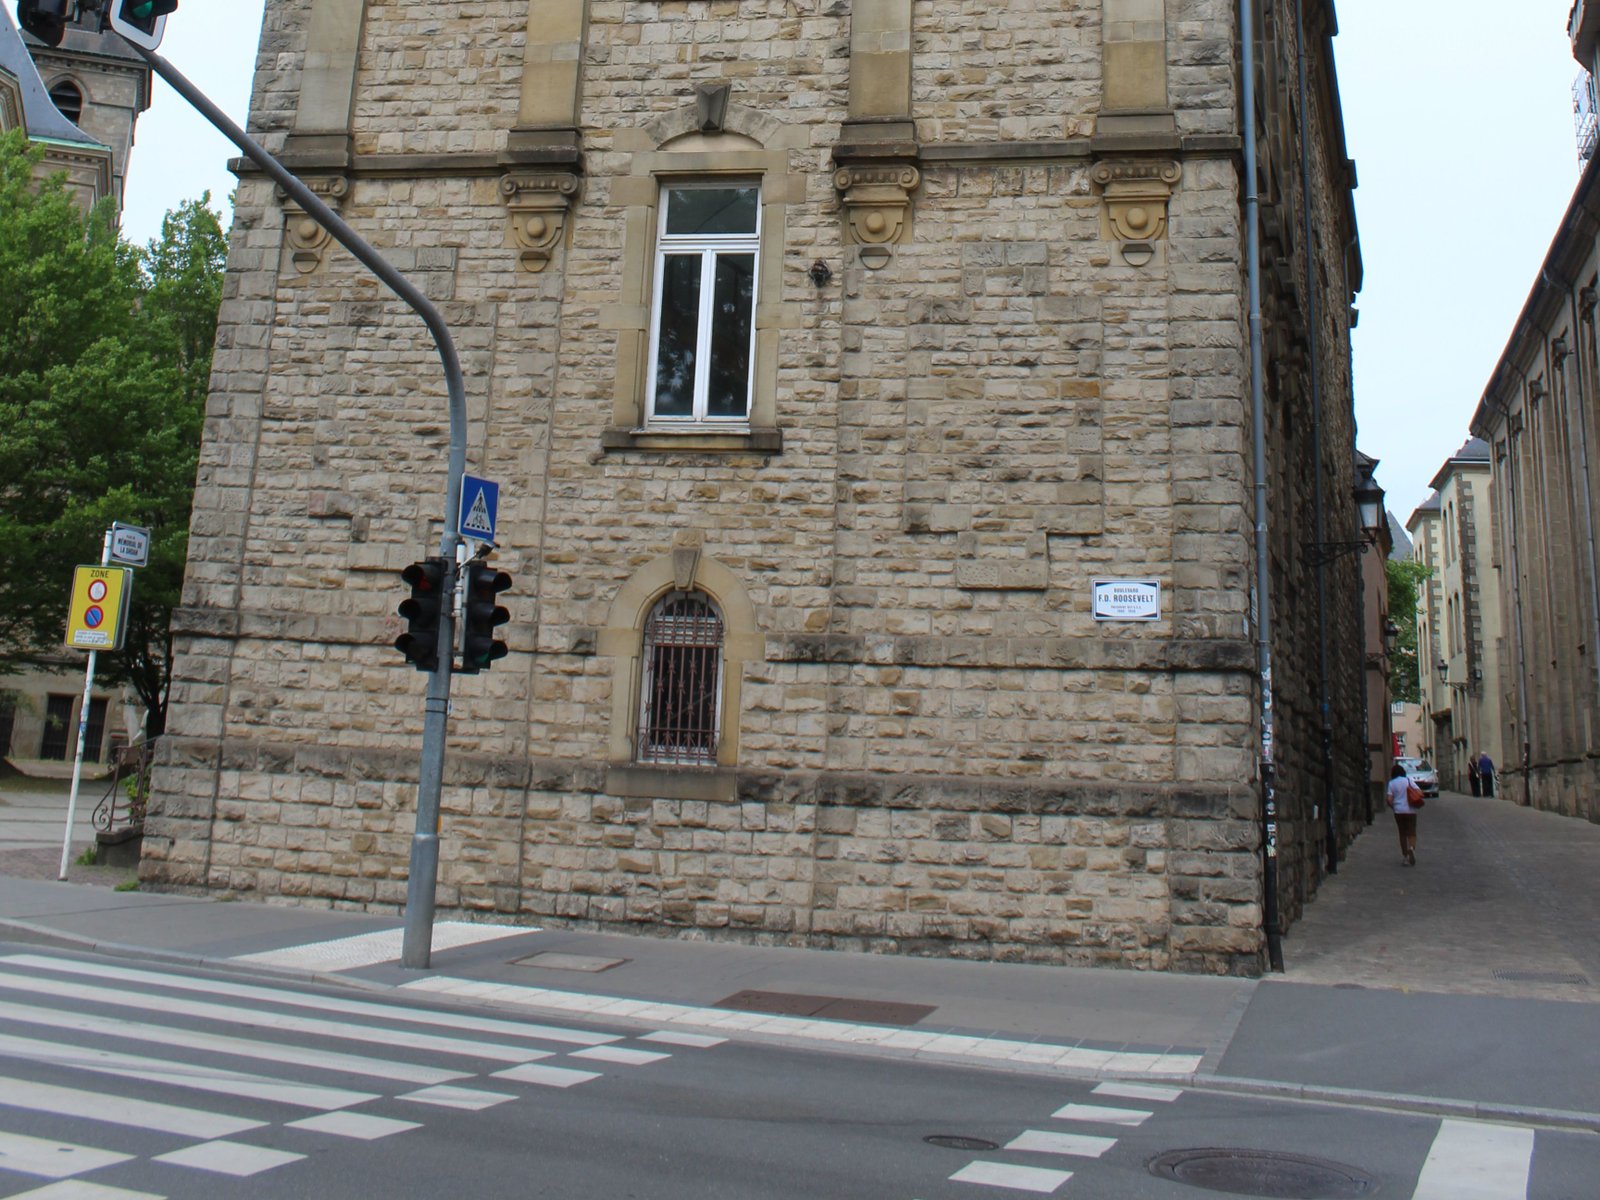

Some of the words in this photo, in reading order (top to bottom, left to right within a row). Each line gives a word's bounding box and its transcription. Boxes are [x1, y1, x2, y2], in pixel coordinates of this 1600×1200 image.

[90, 569, 110, 579] ZONE
[1098, 594, 1112, 603] F.D.
[1113, 594, 1154, 603] ROOSEVELT
